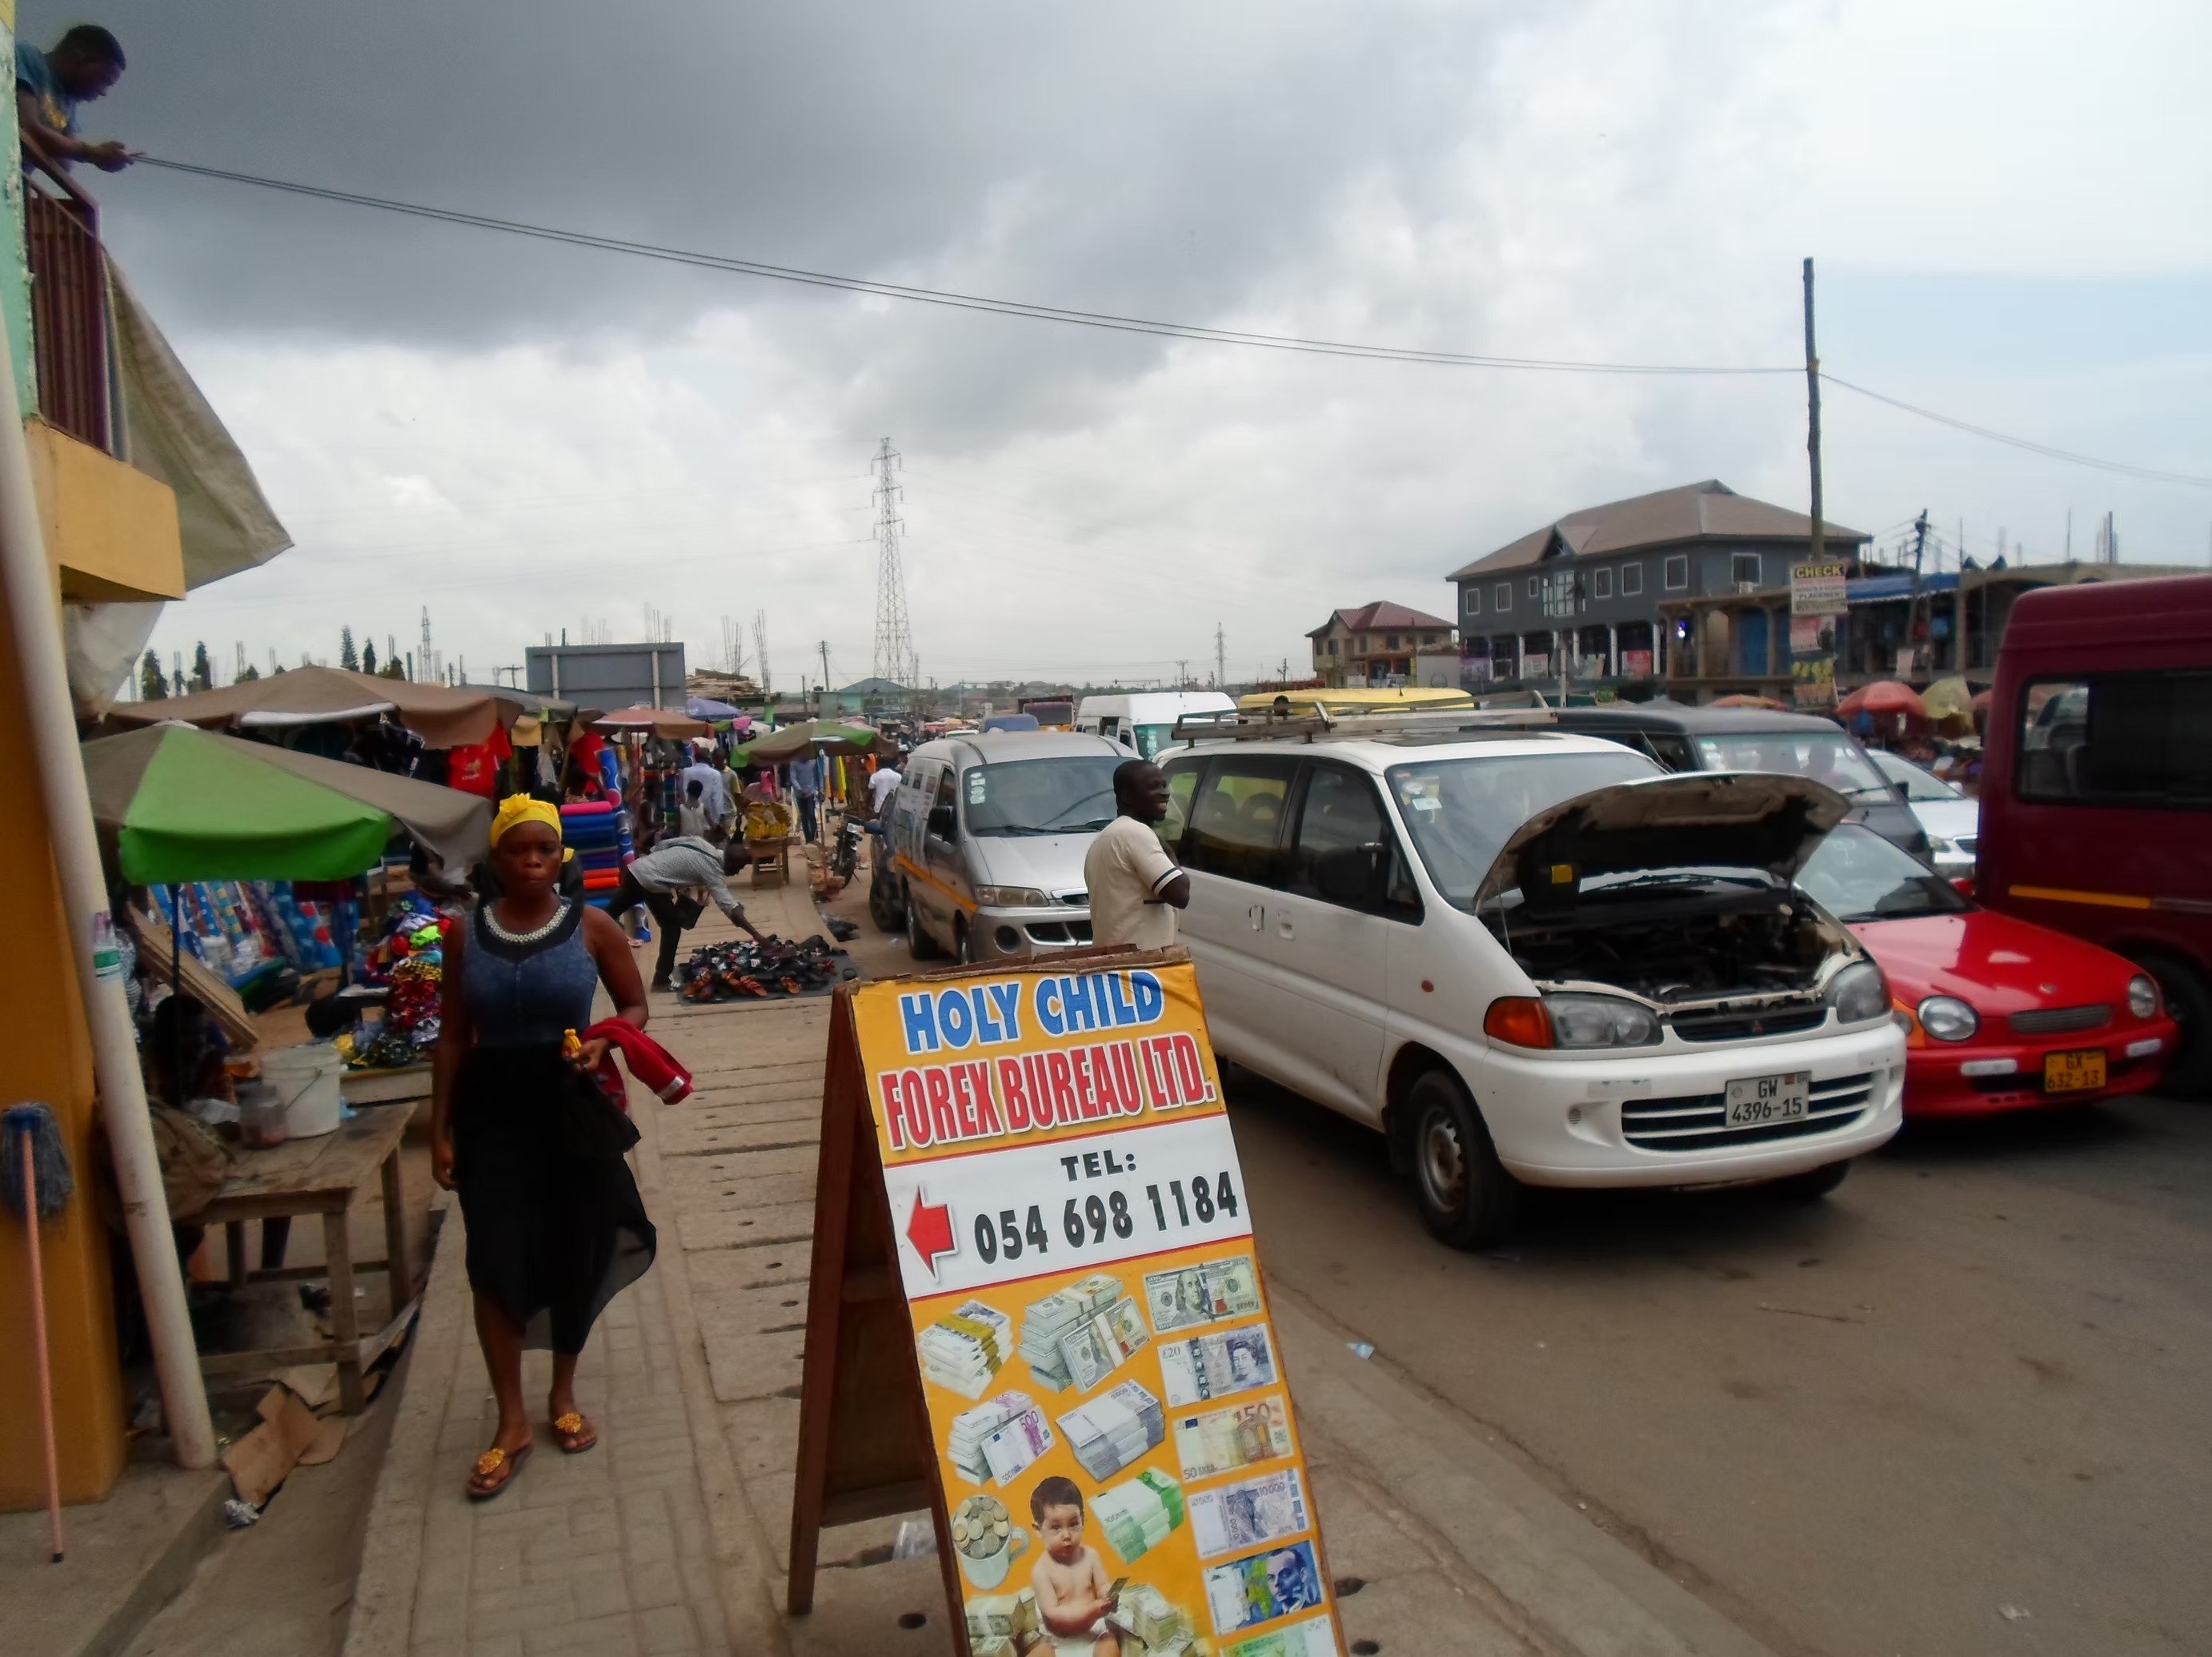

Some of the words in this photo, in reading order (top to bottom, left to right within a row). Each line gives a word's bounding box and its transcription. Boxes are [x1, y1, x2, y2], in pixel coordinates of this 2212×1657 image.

[1796, 564, 1842, 578] CHECK
[900, 981, 1022, 1054] HOLY
[1035, 970, 1164, 1037] CHILD
[879, 1060, 1004, 1150] FOREX
[996, 1041, 1144, 1133] BUREAU
[1137, 1033, 1217, 1111] LTD.
[1758, 1079, 1777, 1098] GW
[1732, 1096, 1803, 1122] 4396-15
[1060, 1149, 1137, 1182] TEL:
[974, 1204, 1048, 1265] 054
[1063, 1190, 1133, 1249] 698
[1145, 1170, 1239, 1232] 1184
[1162, 1346, 1181, 1360] £20
[1019, 1410, 1040, 1430] 500
[1244, 1402, 1271, 1422] 50
[1184, 1466, 1197, 1480] 50
